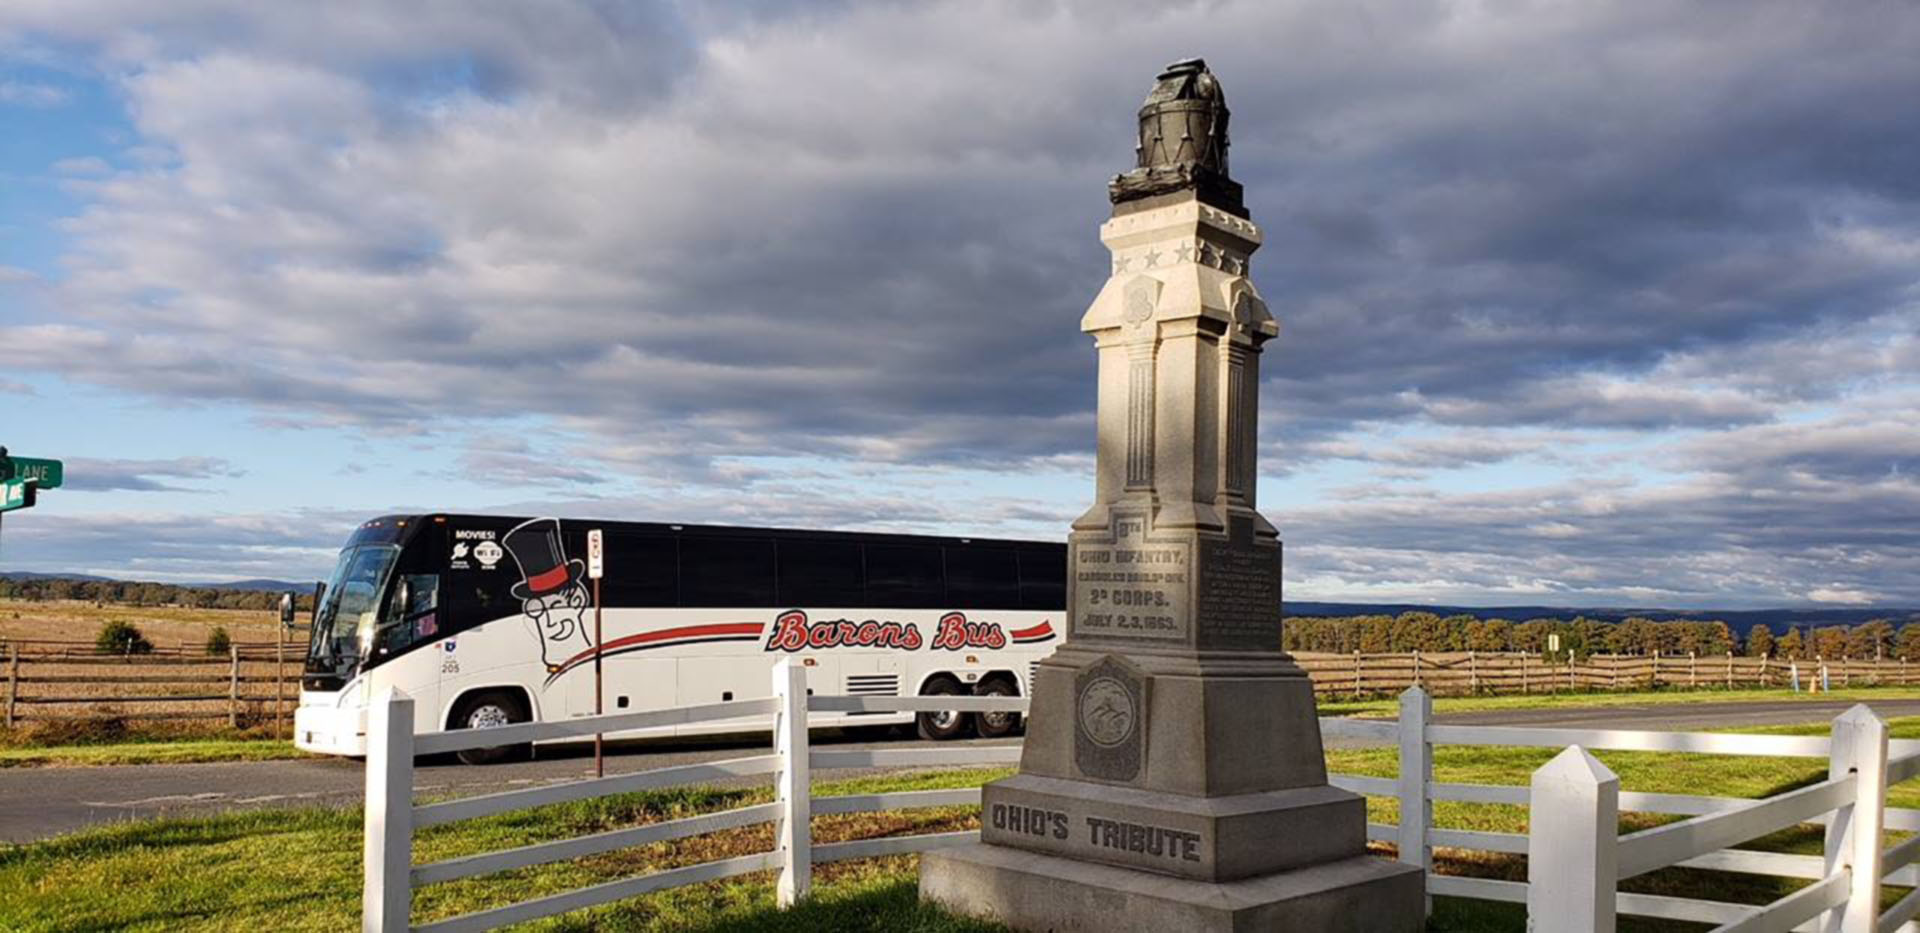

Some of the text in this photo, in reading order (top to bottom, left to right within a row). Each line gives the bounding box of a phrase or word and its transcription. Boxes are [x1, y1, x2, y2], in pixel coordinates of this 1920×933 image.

[1112, 590, 1170, 606] CORPS.
[1084, 614, 1112, 627] JULY
[765, 609, 1006, 652] Barons Bus
[442, 663, 460, 673] 205
[992, 803, 1201, 862] OHIO'S TRIBUTE
